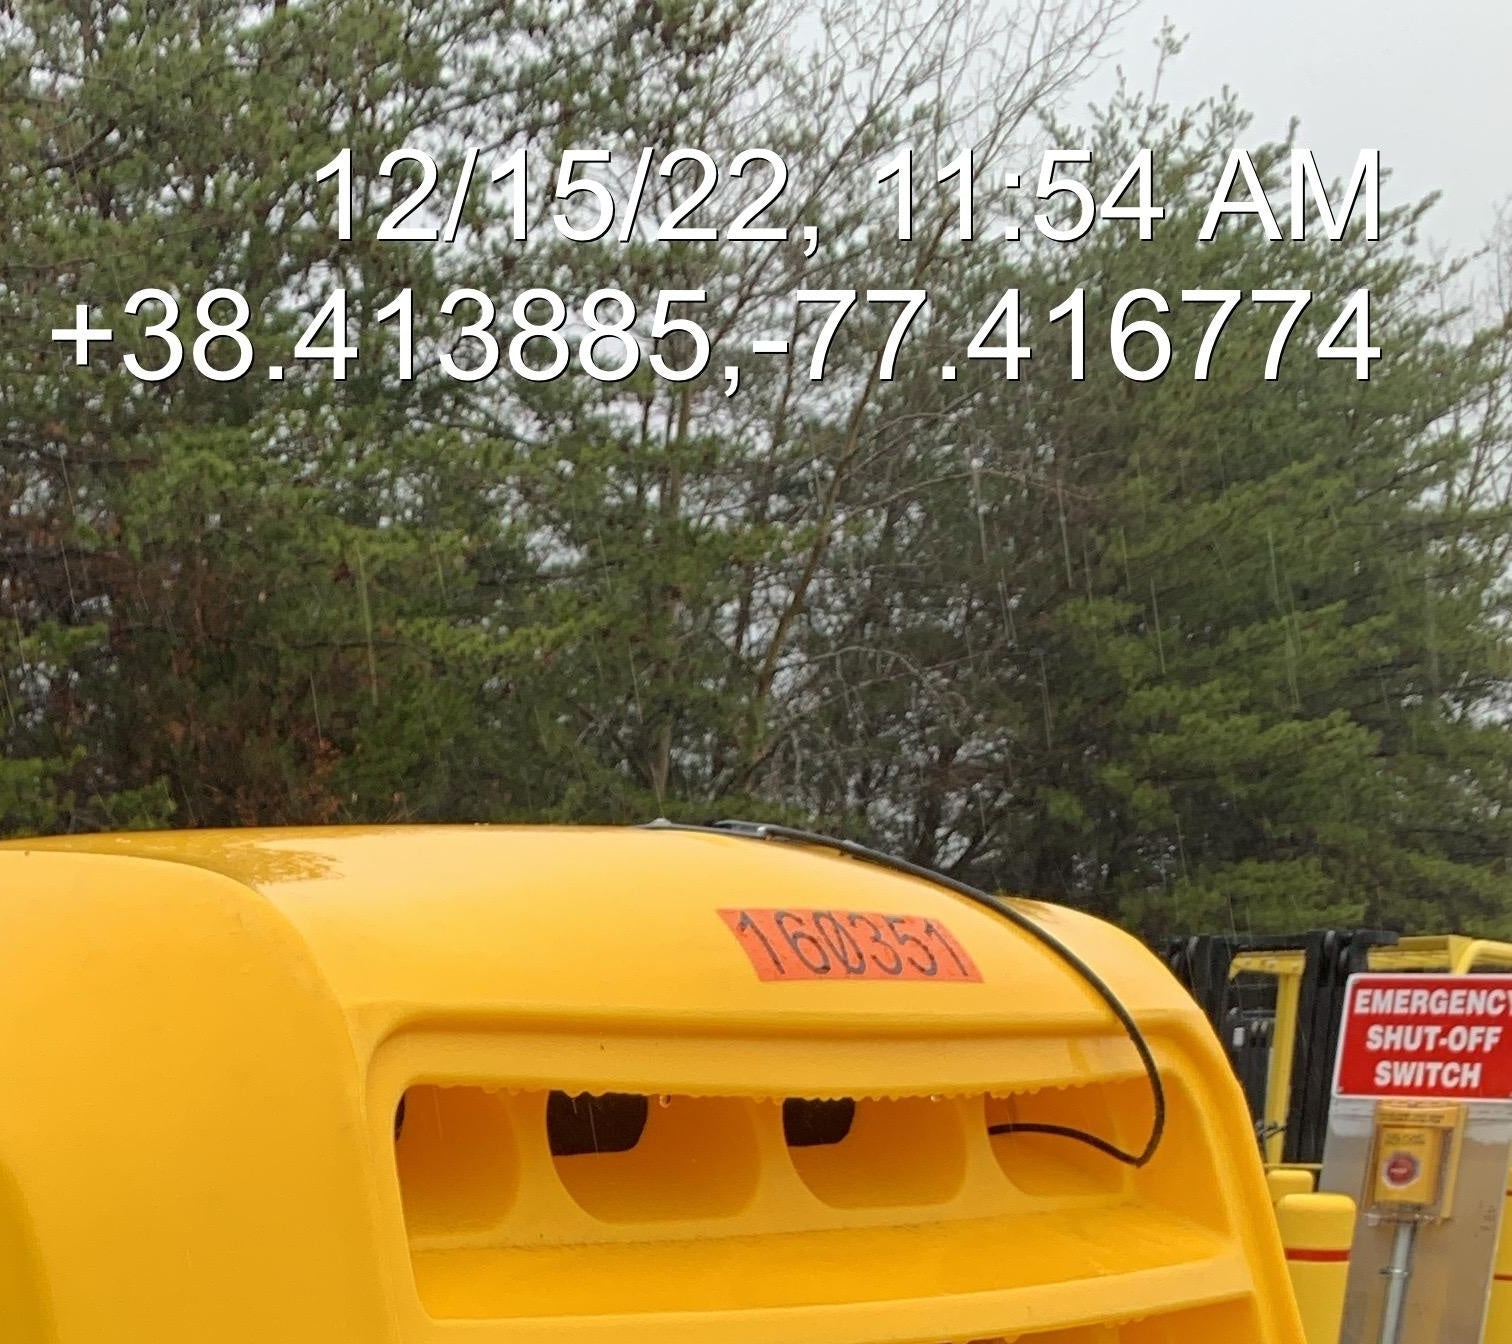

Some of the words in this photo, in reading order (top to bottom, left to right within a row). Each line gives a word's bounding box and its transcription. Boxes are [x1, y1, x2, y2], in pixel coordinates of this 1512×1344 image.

[737, 908, 969, 977] 160351
[1353, 988, 1512, 1017] EMERGENC
[1365, 1024, 1504, 1054] SHUT-OFF
[1374, 1060, 1482, 1089] SWITCH
